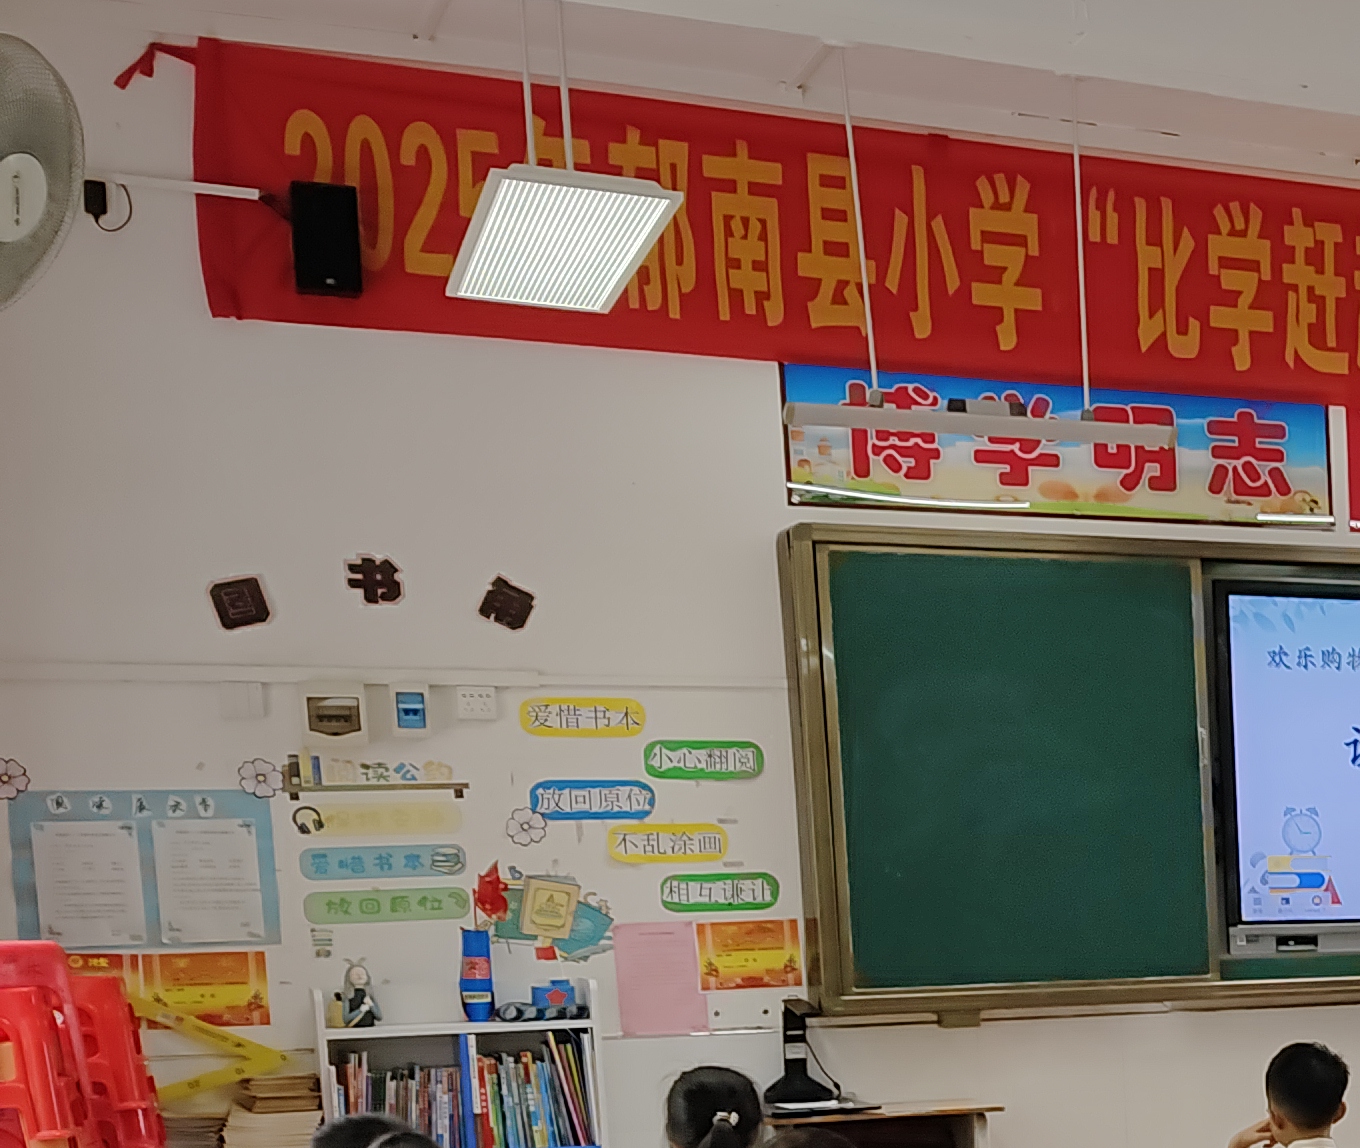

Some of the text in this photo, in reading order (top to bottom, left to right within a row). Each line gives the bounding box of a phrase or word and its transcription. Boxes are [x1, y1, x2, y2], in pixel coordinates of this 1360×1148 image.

[841, 381, 1293, 498] 博学明志
[526, 703, 642, 731] 爱惜书本
[649, 745, 757, 773] 小心翻阅
[537, 787, 652, 812] 放回原位
[612, 831, 723, 856] 不乱涂画
[665, 879, 772, 904] 相互谦让
[326, 895, 443, 915] 放回原位
